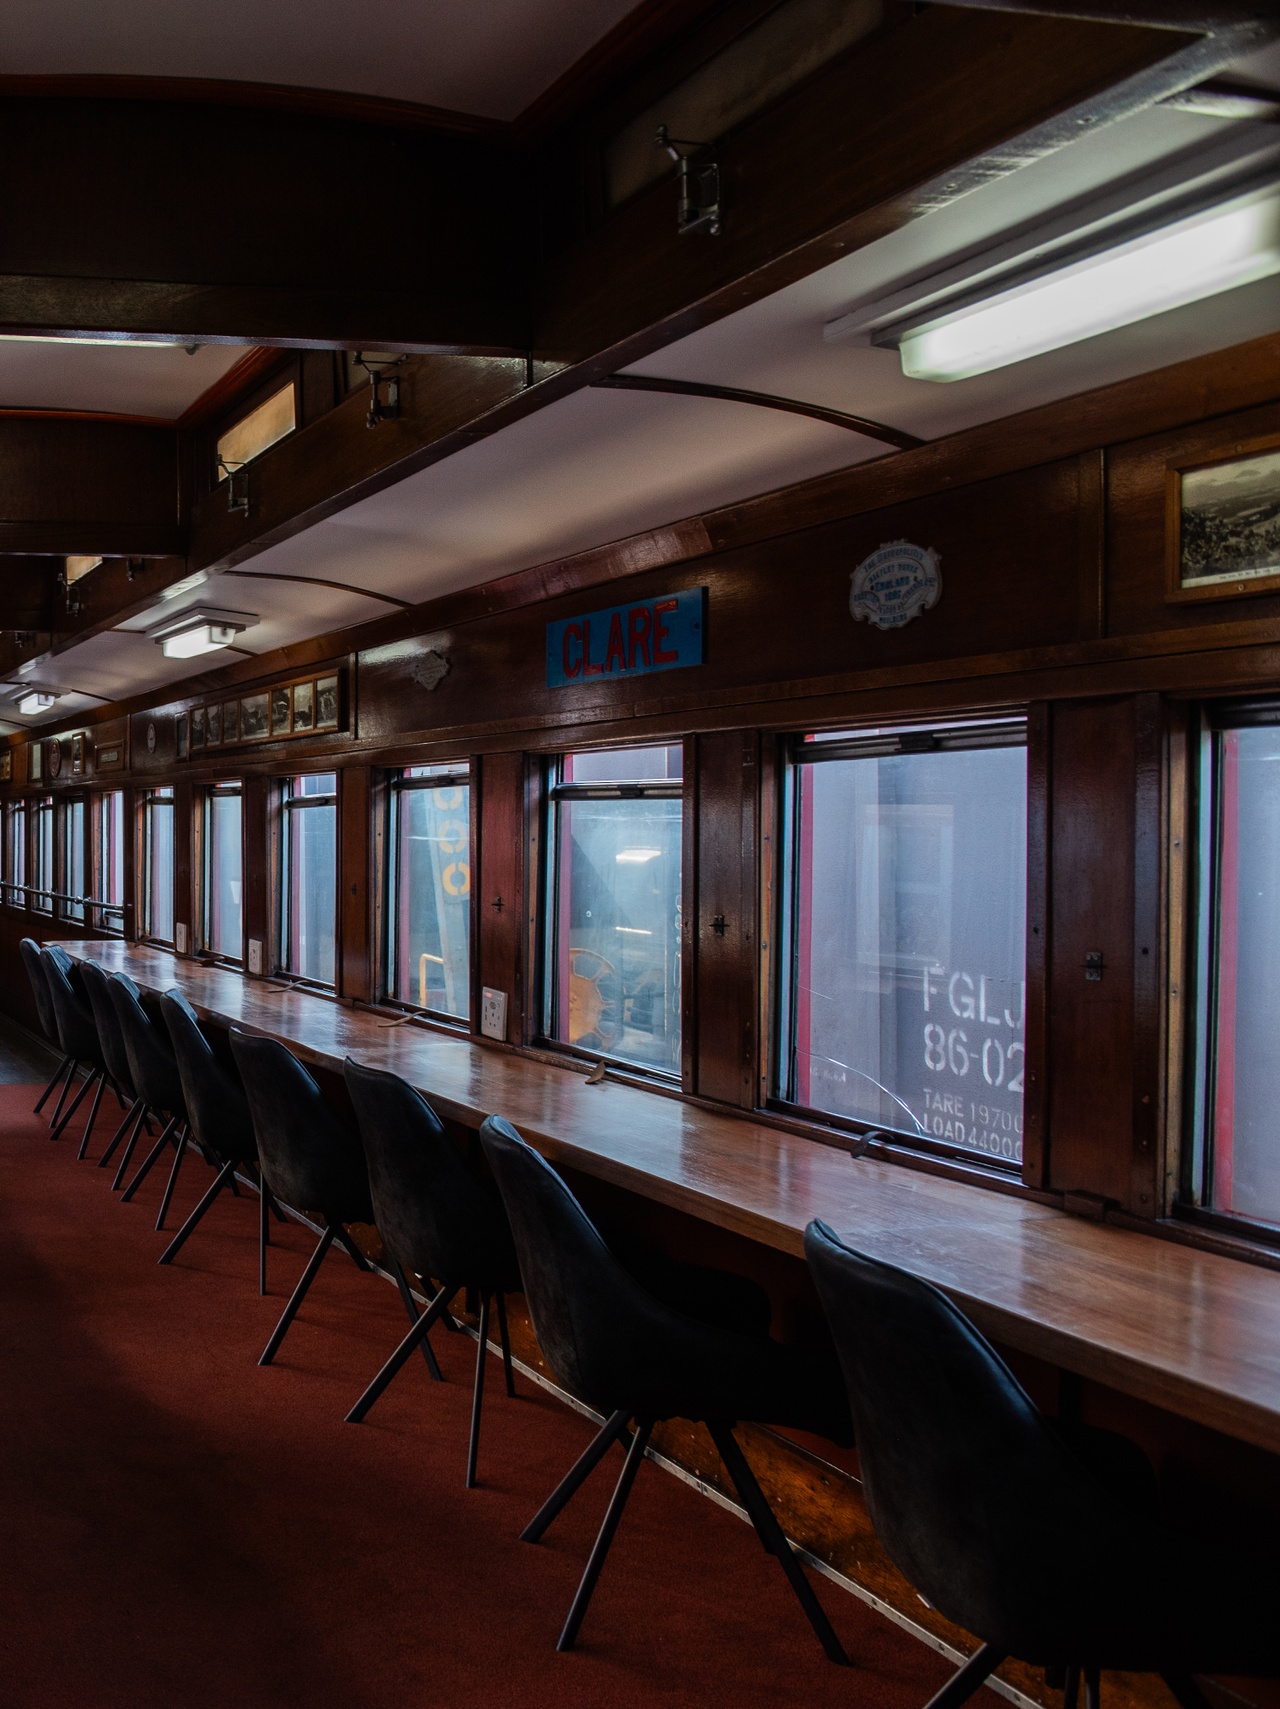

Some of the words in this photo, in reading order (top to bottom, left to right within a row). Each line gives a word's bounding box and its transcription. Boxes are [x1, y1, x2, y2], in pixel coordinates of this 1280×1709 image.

[562, 598, 678, 679] CLARE
[923, 966, 1026, 1029] FGLJ
[923, 1023, 1025, 1093] 86-02
[923, 1088, 964, 1118] TARE
[923, 1113, 965, 1143] LOAD
